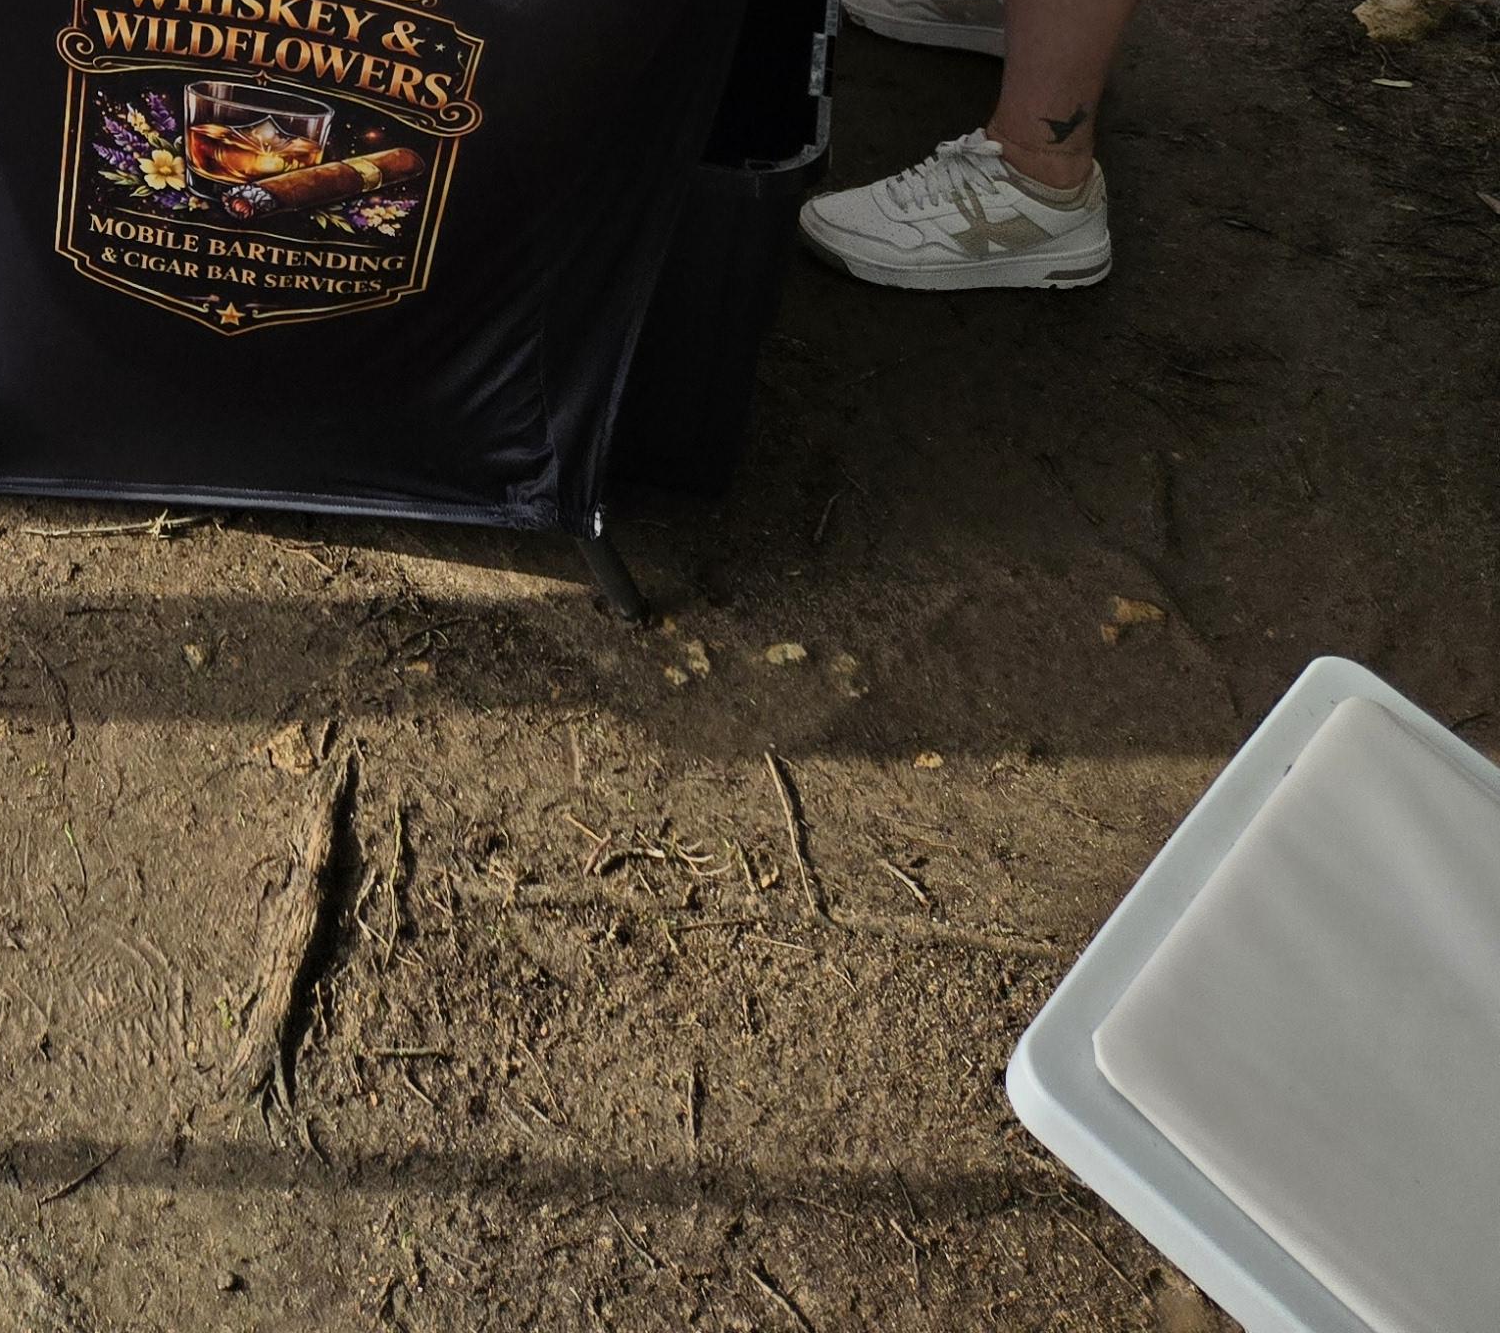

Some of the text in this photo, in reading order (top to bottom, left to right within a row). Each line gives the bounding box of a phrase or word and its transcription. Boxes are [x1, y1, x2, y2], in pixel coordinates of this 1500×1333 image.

[94, 8, 453, 110] WILDFLOWERS
[382, 19, 426, 57] &
[88, 213, 406, 273] MOBILE BARTENDING
[101, 245, 382, 295] & CIGAR BAR SERVICES
